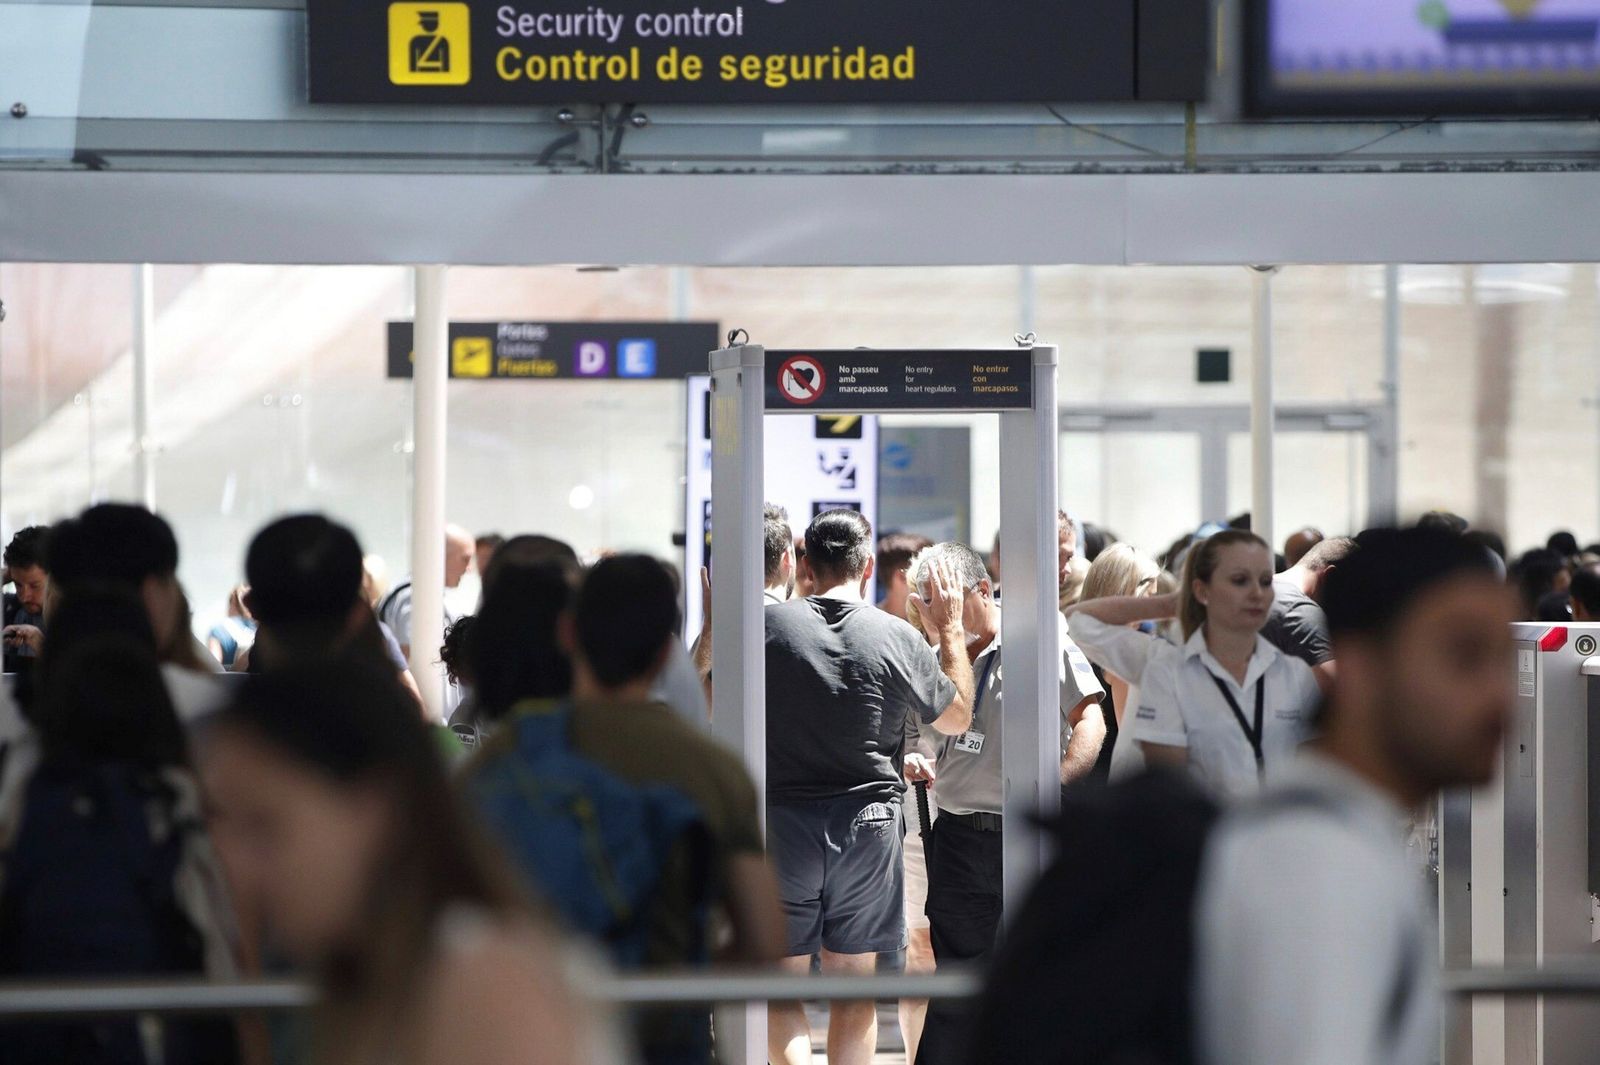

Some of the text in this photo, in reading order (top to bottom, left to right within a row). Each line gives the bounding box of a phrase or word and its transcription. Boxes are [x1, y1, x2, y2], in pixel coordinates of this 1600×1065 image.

[496, 5, 743, 43] Security control
[496, 46, 915, 88] Control de seguridad
[579, 341, 606, 374] D
[625, 341, 650, 374] E
[839, 365, 879, 375] No passeu
[905, 365, 934, 375] No entry
[972, 364, 1009, 373] No entrar
[838, 375, 856, 383] amb
[905, 375, 914, 383] for
[972, 375, 987, 383] con
[838, 386, 888, 394] marcapassos
[905, 385, 957, 394] heart regulators
[972, 385, 1019, 394] marcapasos
[968, 740, 980, 750] 20
